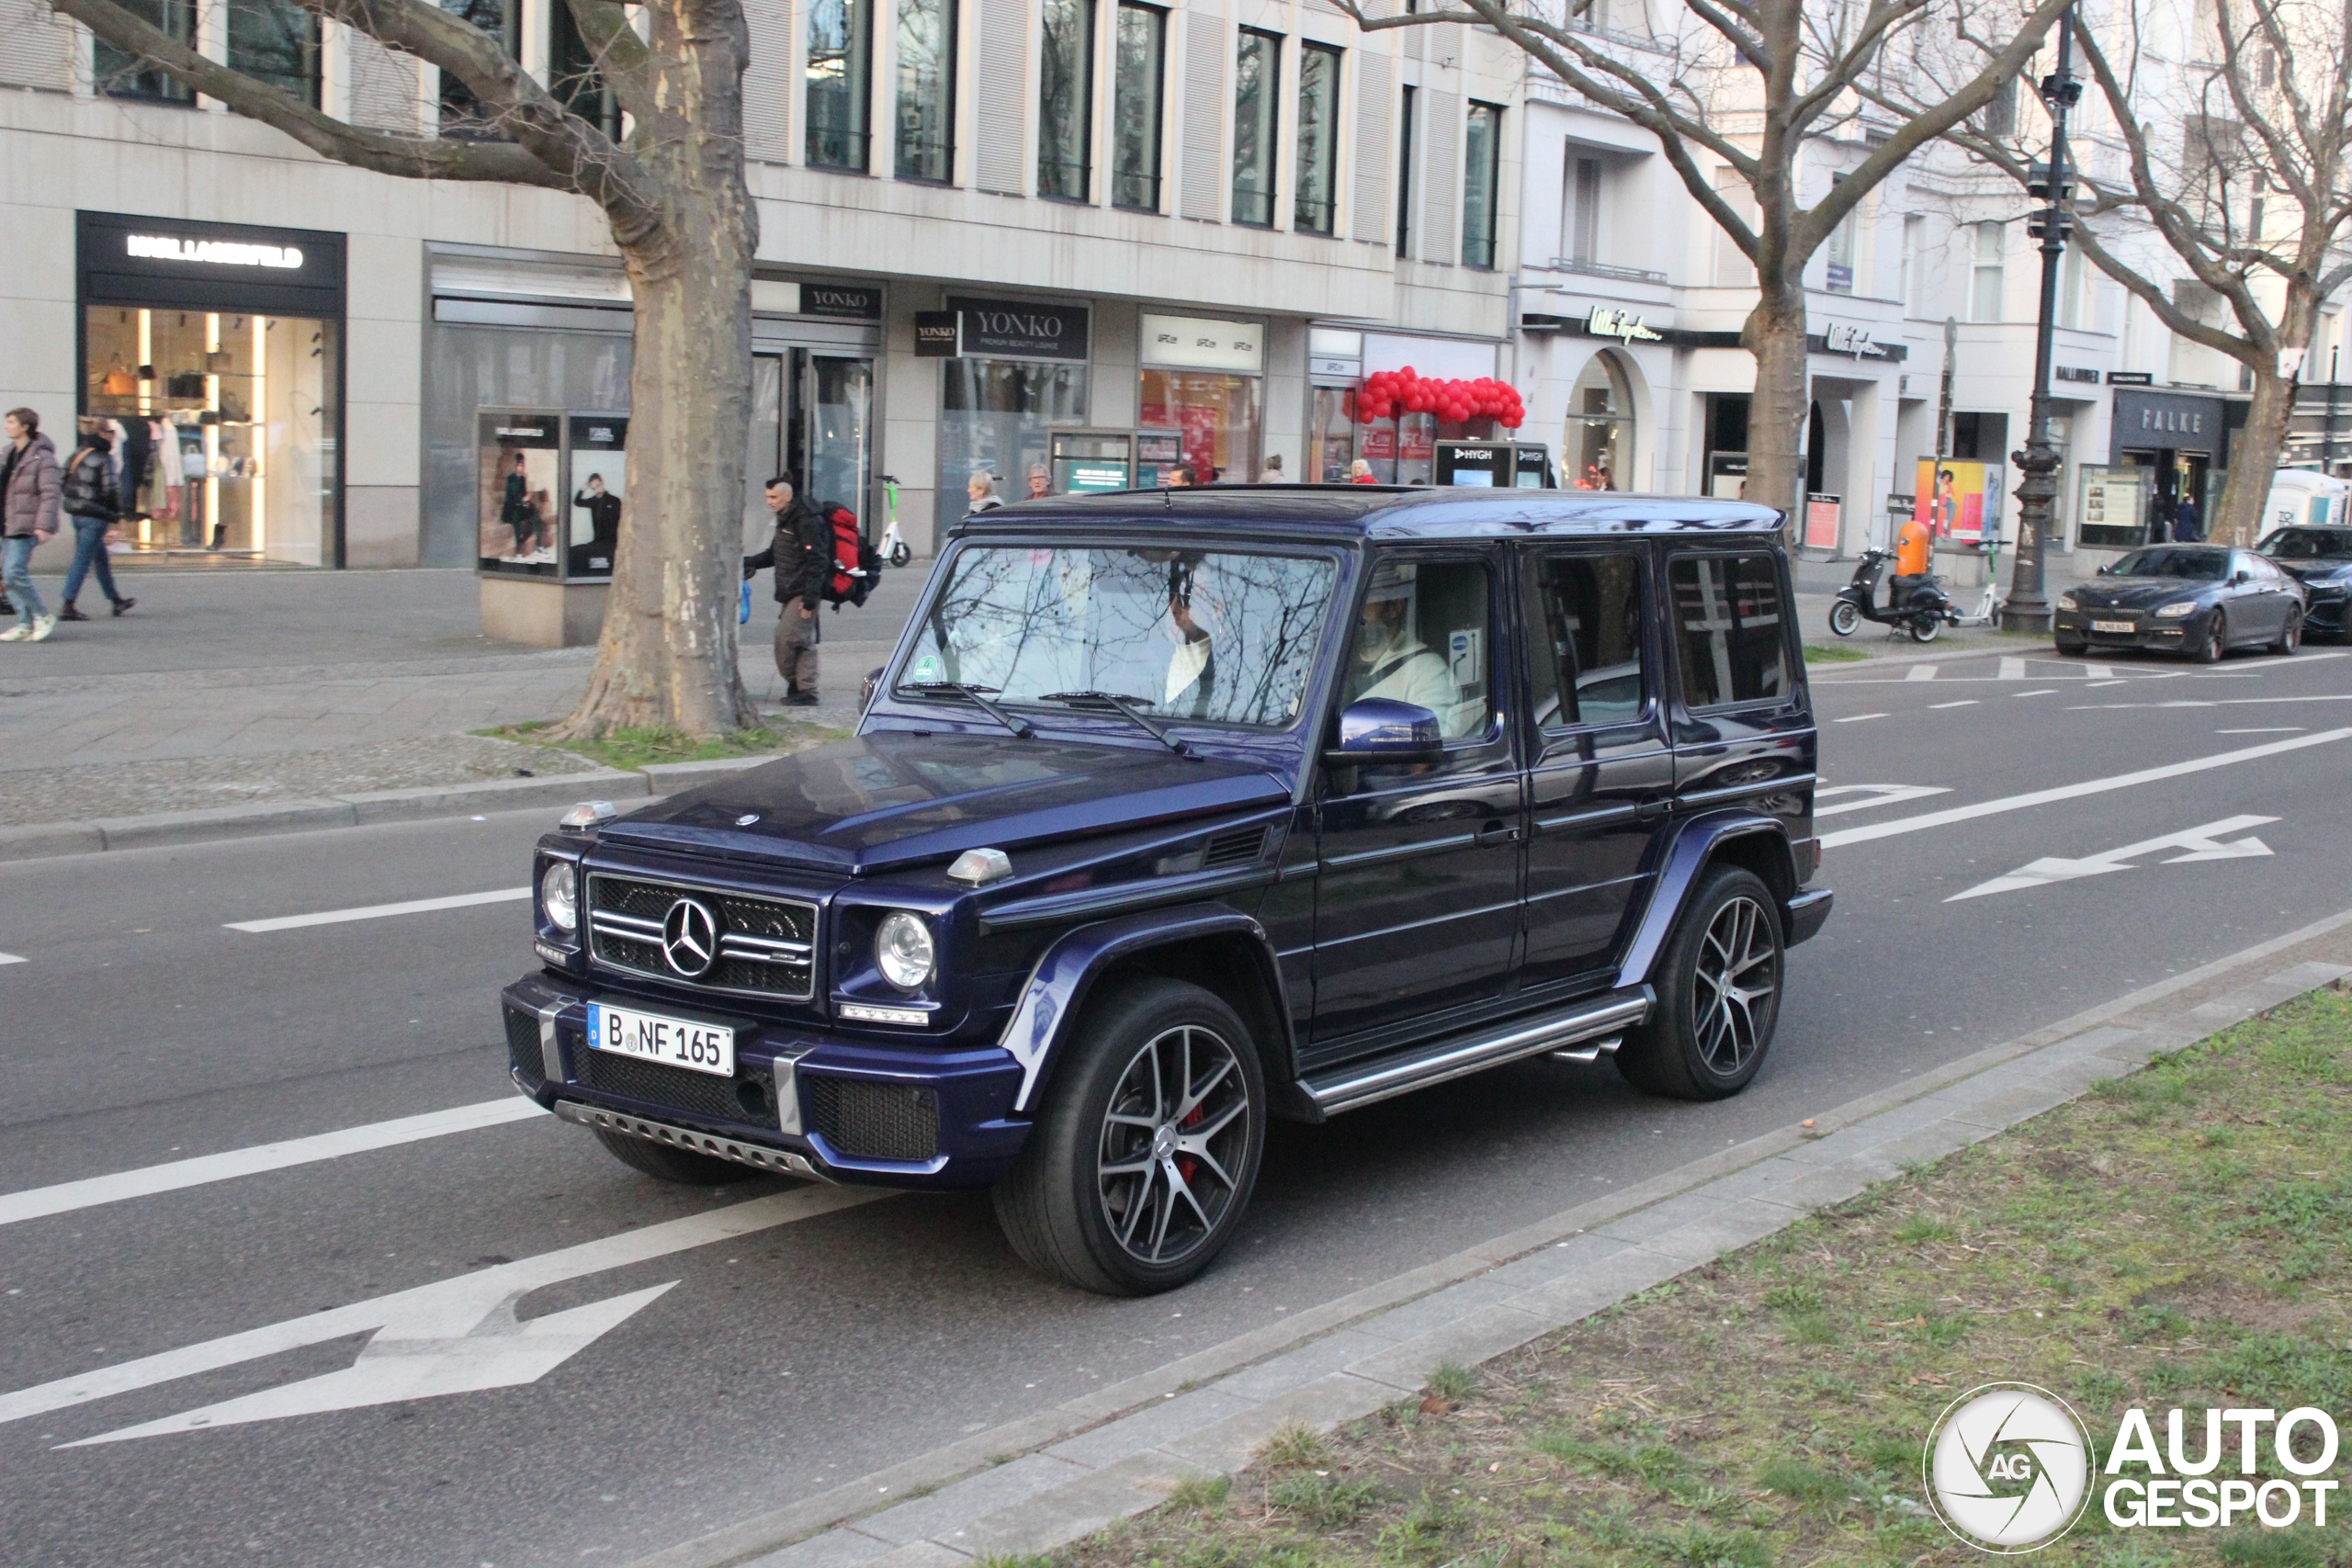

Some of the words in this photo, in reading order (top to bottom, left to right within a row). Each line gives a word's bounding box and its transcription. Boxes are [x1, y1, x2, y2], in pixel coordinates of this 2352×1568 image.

[812, 290, 867, 307] YONKO
[919, 327, 956, 337] YONKO
[977, 311, 1062, 337] YONKO
[2142, 409, 2202, 434] FALKE
[1464, 449, 1493, 460] HYGH
[591, 1029, 597, 1040] D
[609, 1013, 623, 1047] B
[639, 1019, 670, 1055] NF
[675, 1027, 720, 1066] 165
